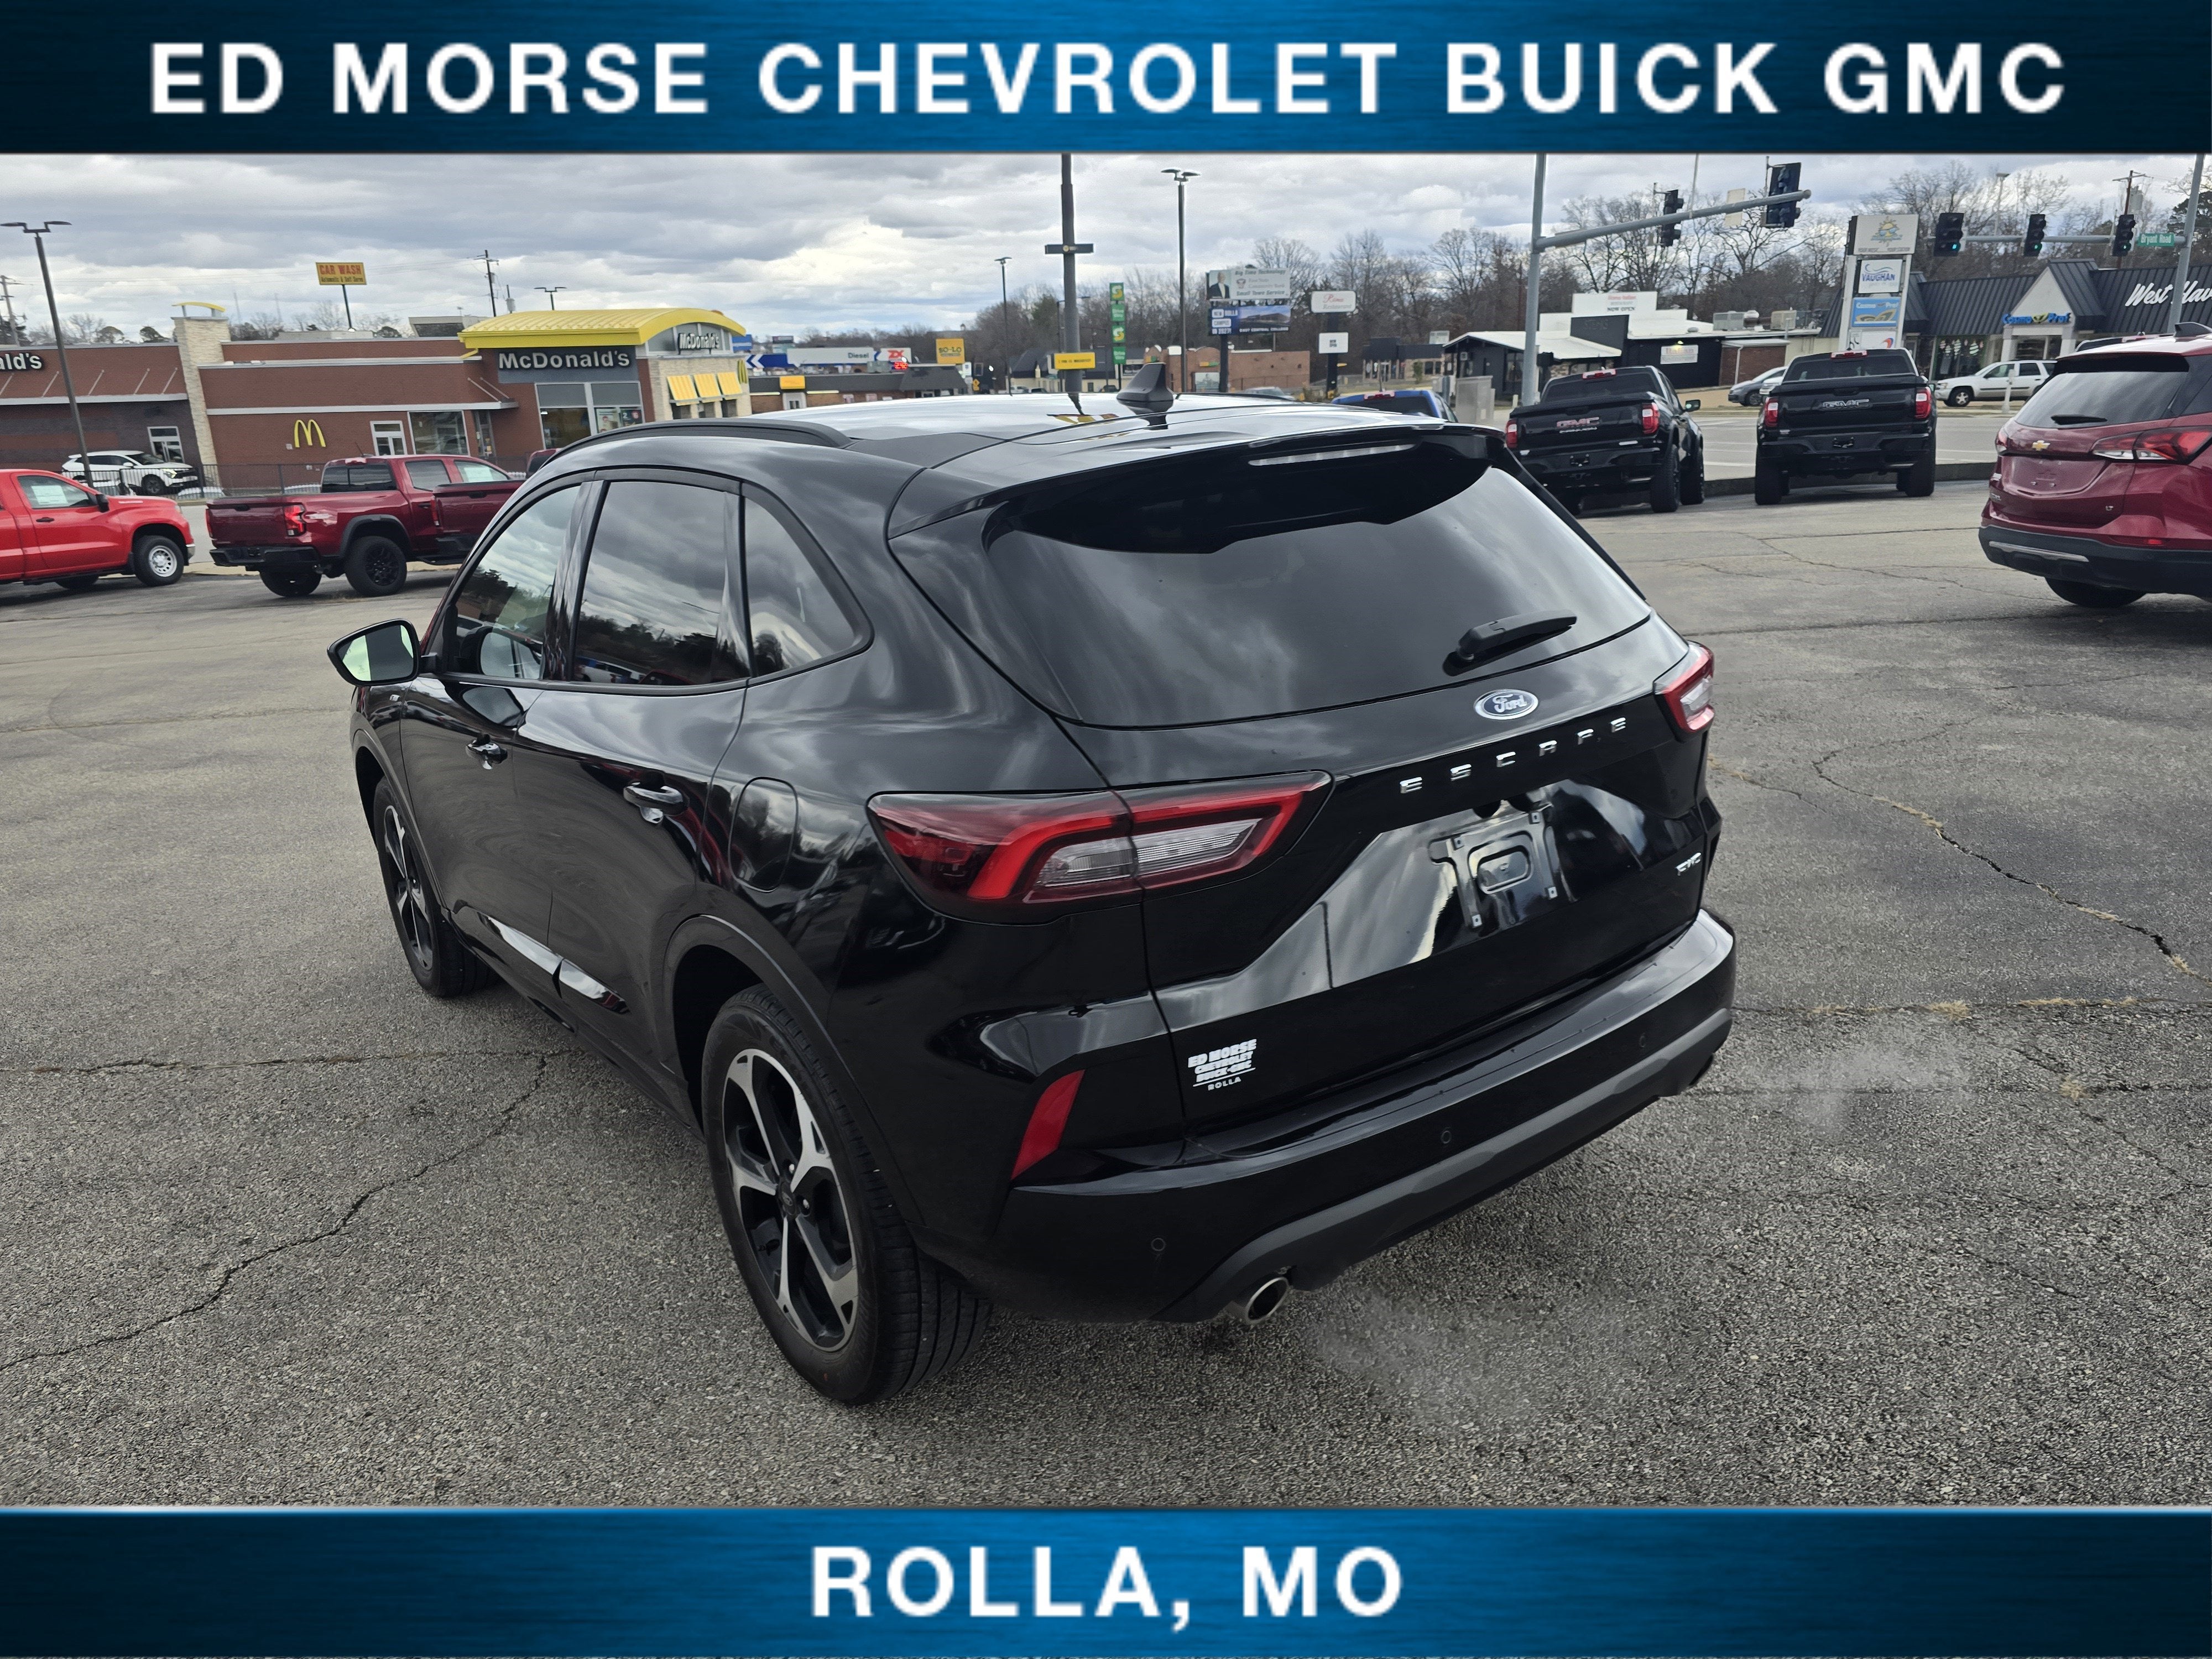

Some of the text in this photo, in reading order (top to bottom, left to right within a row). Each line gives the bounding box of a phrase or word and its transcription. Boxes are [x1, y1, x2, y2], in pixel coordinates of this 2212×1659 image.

[2141, 234, 2171, 245] Bryant Road
[319, 265, 362, 274] CAR WASH
[2125, 282, 2173, 306] West
[2002, 312, 2072, 324] Cosmo Prof
[679, 333, 719, 349] McDonald's
[498, 351, 630, 369] McDonald's
[1823, 399, 1869, 410] GMC
[1557, 417, 1600, 428] GMC
[1493, 693, 1527, 713] Ford
[1400, 717, 1626, 794] ESCAPE
[1188, 1039, 1257, 1068] ED MORSE
[1194, 1051, 1254, 1074] CHEVROLET
[1208, 1077, 1242, 1091] ROLLA
